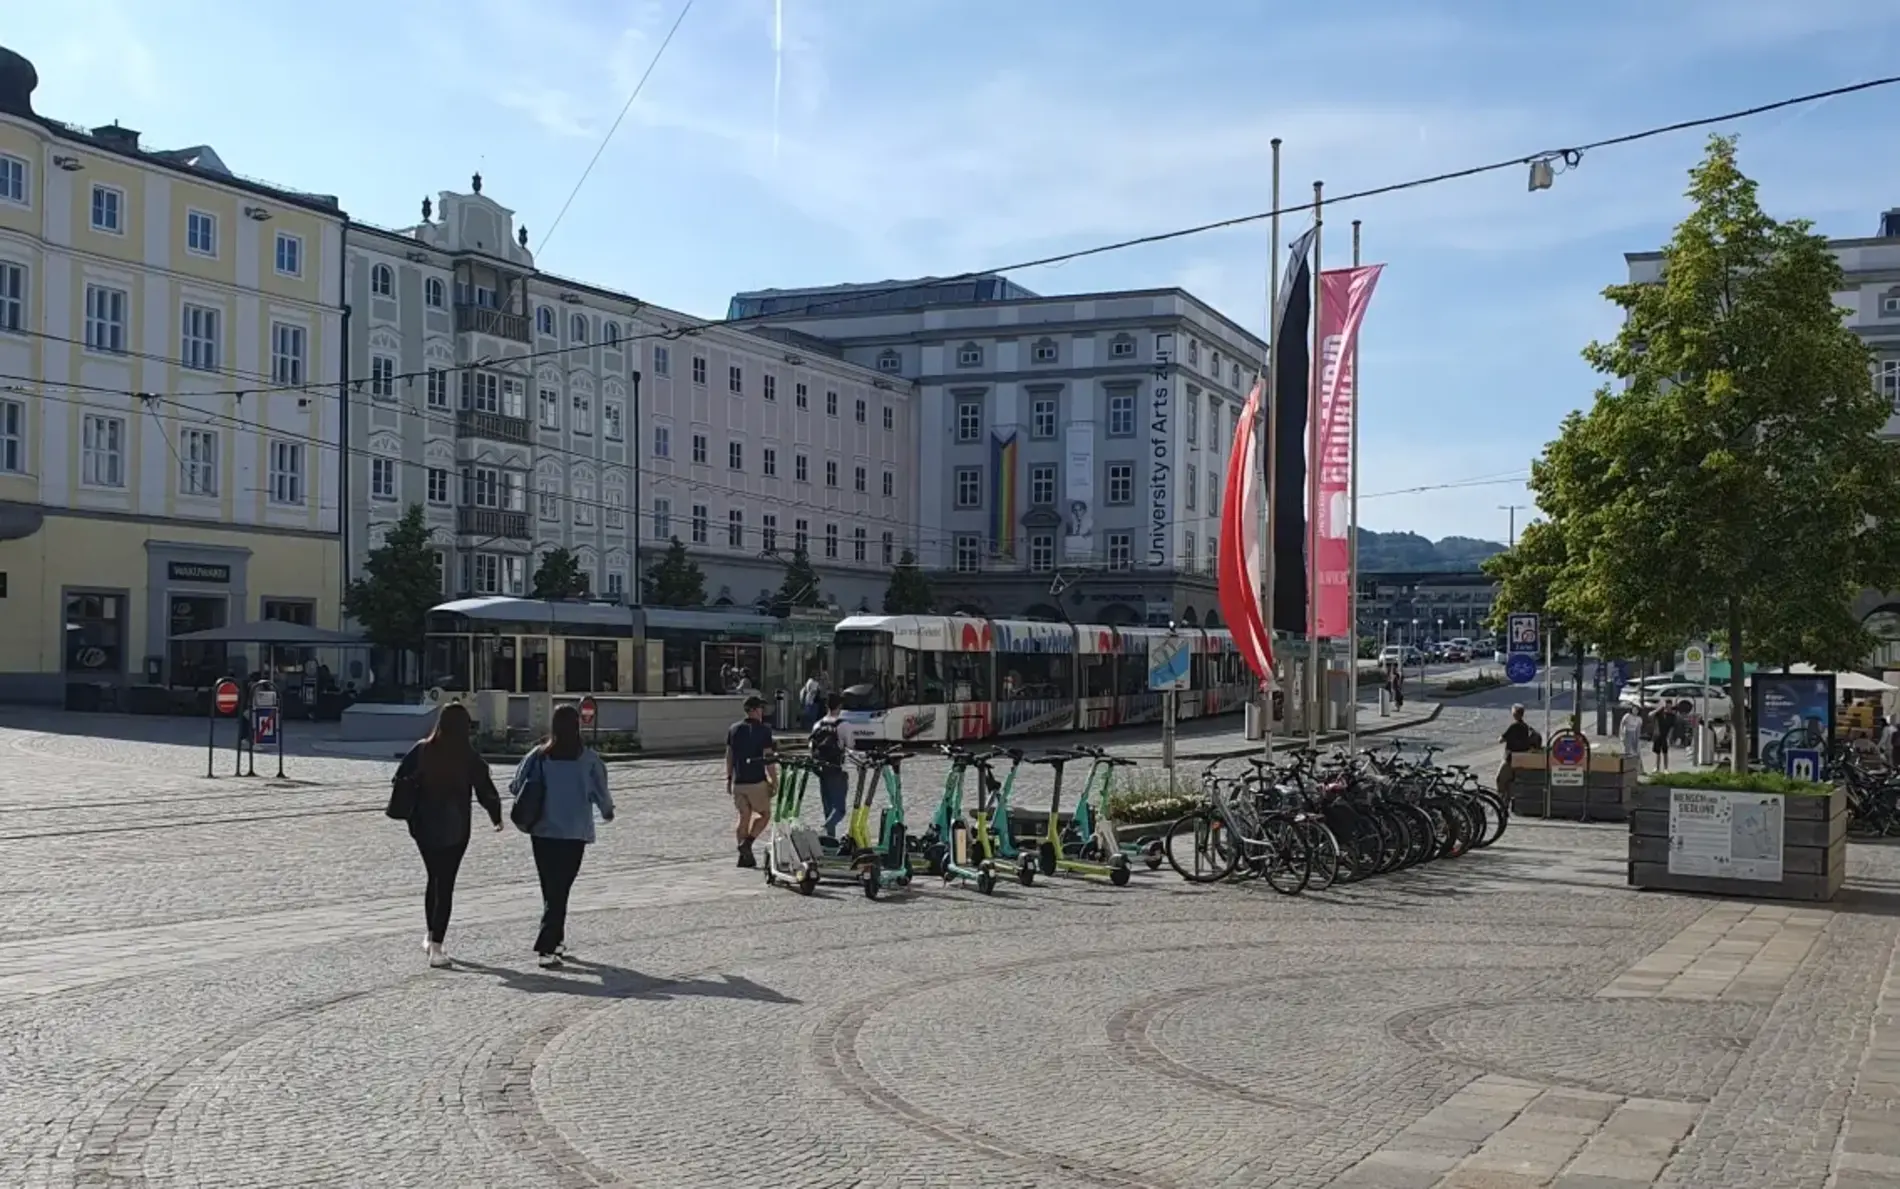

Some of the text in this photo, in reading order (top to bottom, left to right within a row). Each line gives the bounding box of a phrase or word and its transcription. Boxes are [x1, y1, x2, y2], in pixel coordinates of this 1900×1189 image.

[1149, 334, 1172, 567] University of Arts Linz
